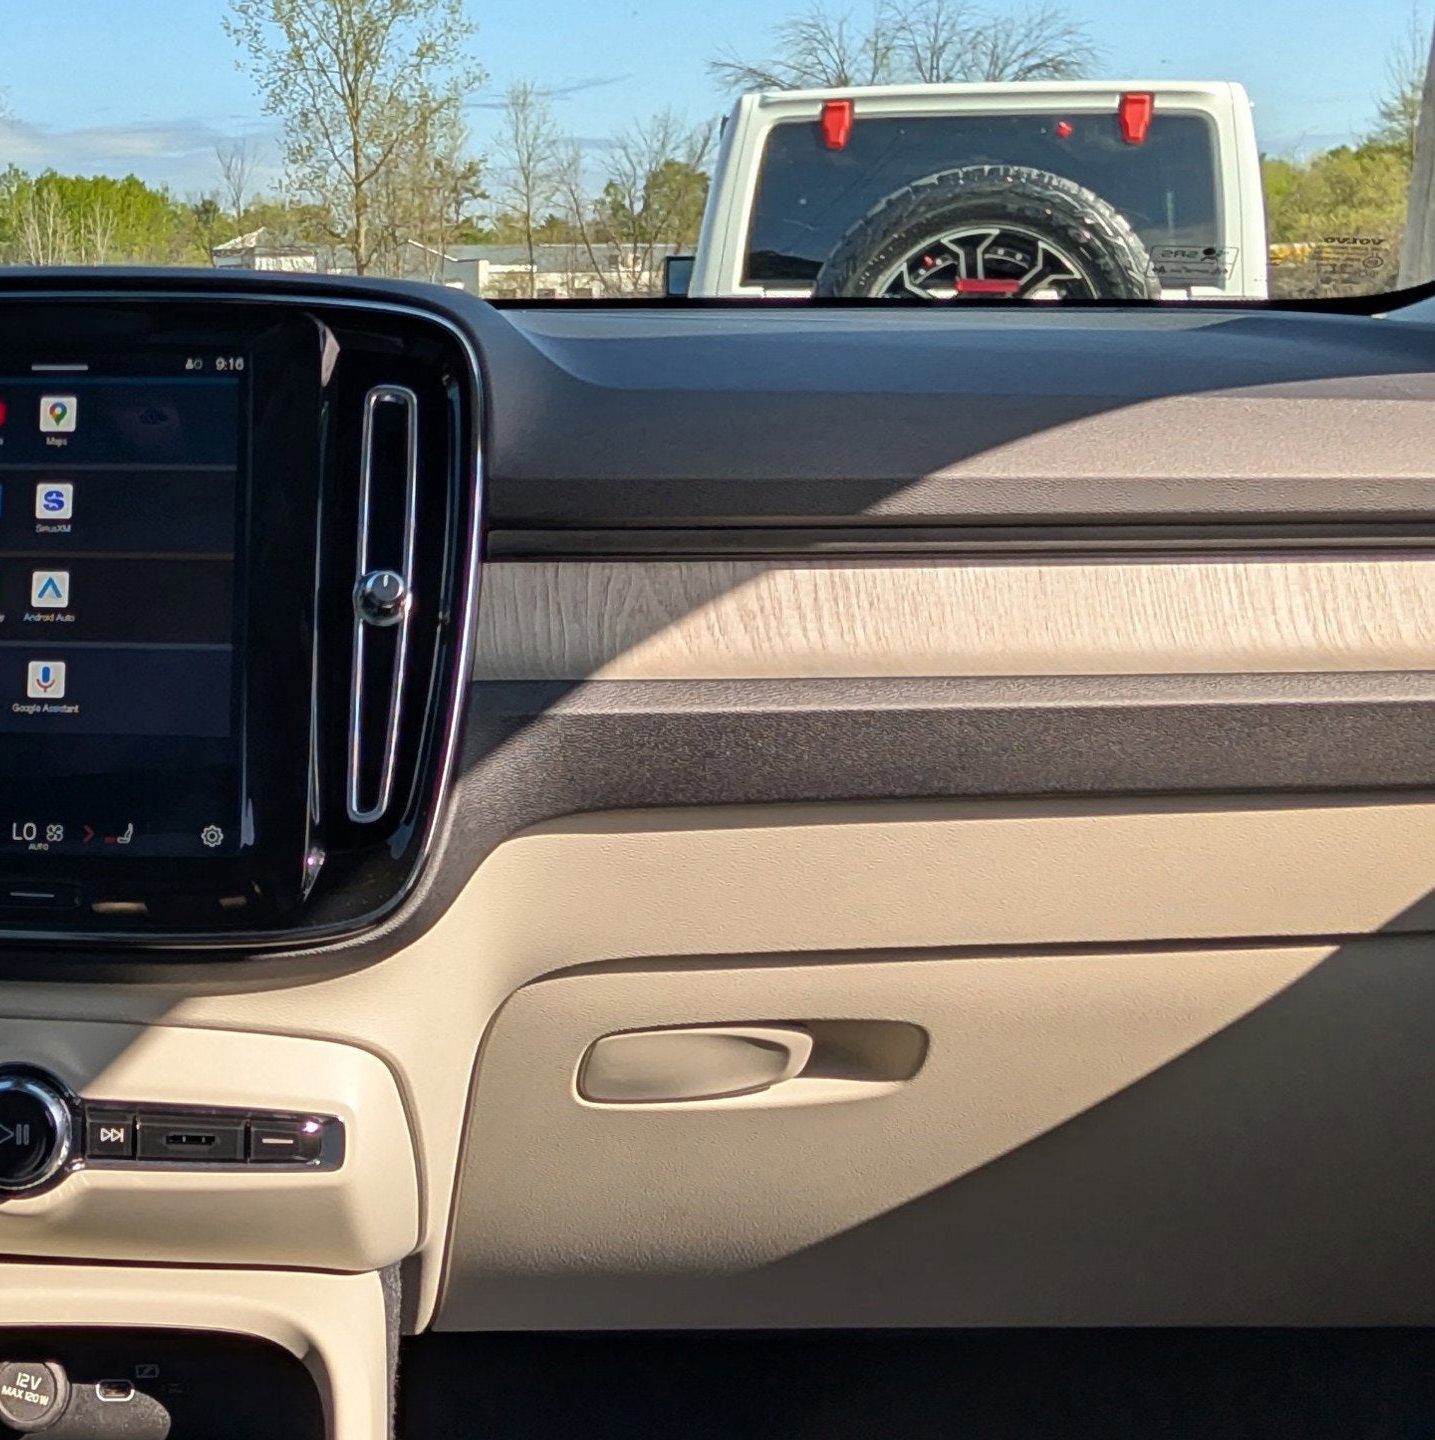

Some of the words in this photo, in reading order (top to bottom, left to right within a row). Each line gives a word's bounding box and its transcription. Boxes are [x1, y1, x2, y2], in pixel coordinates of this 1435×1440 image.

[46, 435, 68, 448] Maps
[23, 612, 55, 623] Android
[56, 612, 75, 623] Auto
[12, 702, 41, 714] Google
[42, 702, 79, 714] Assistant
[28, 843, 50, 851] AUTO
[16, 1371, 43, 1391] 12V
[0, 1384, 24, 1400] MAX
